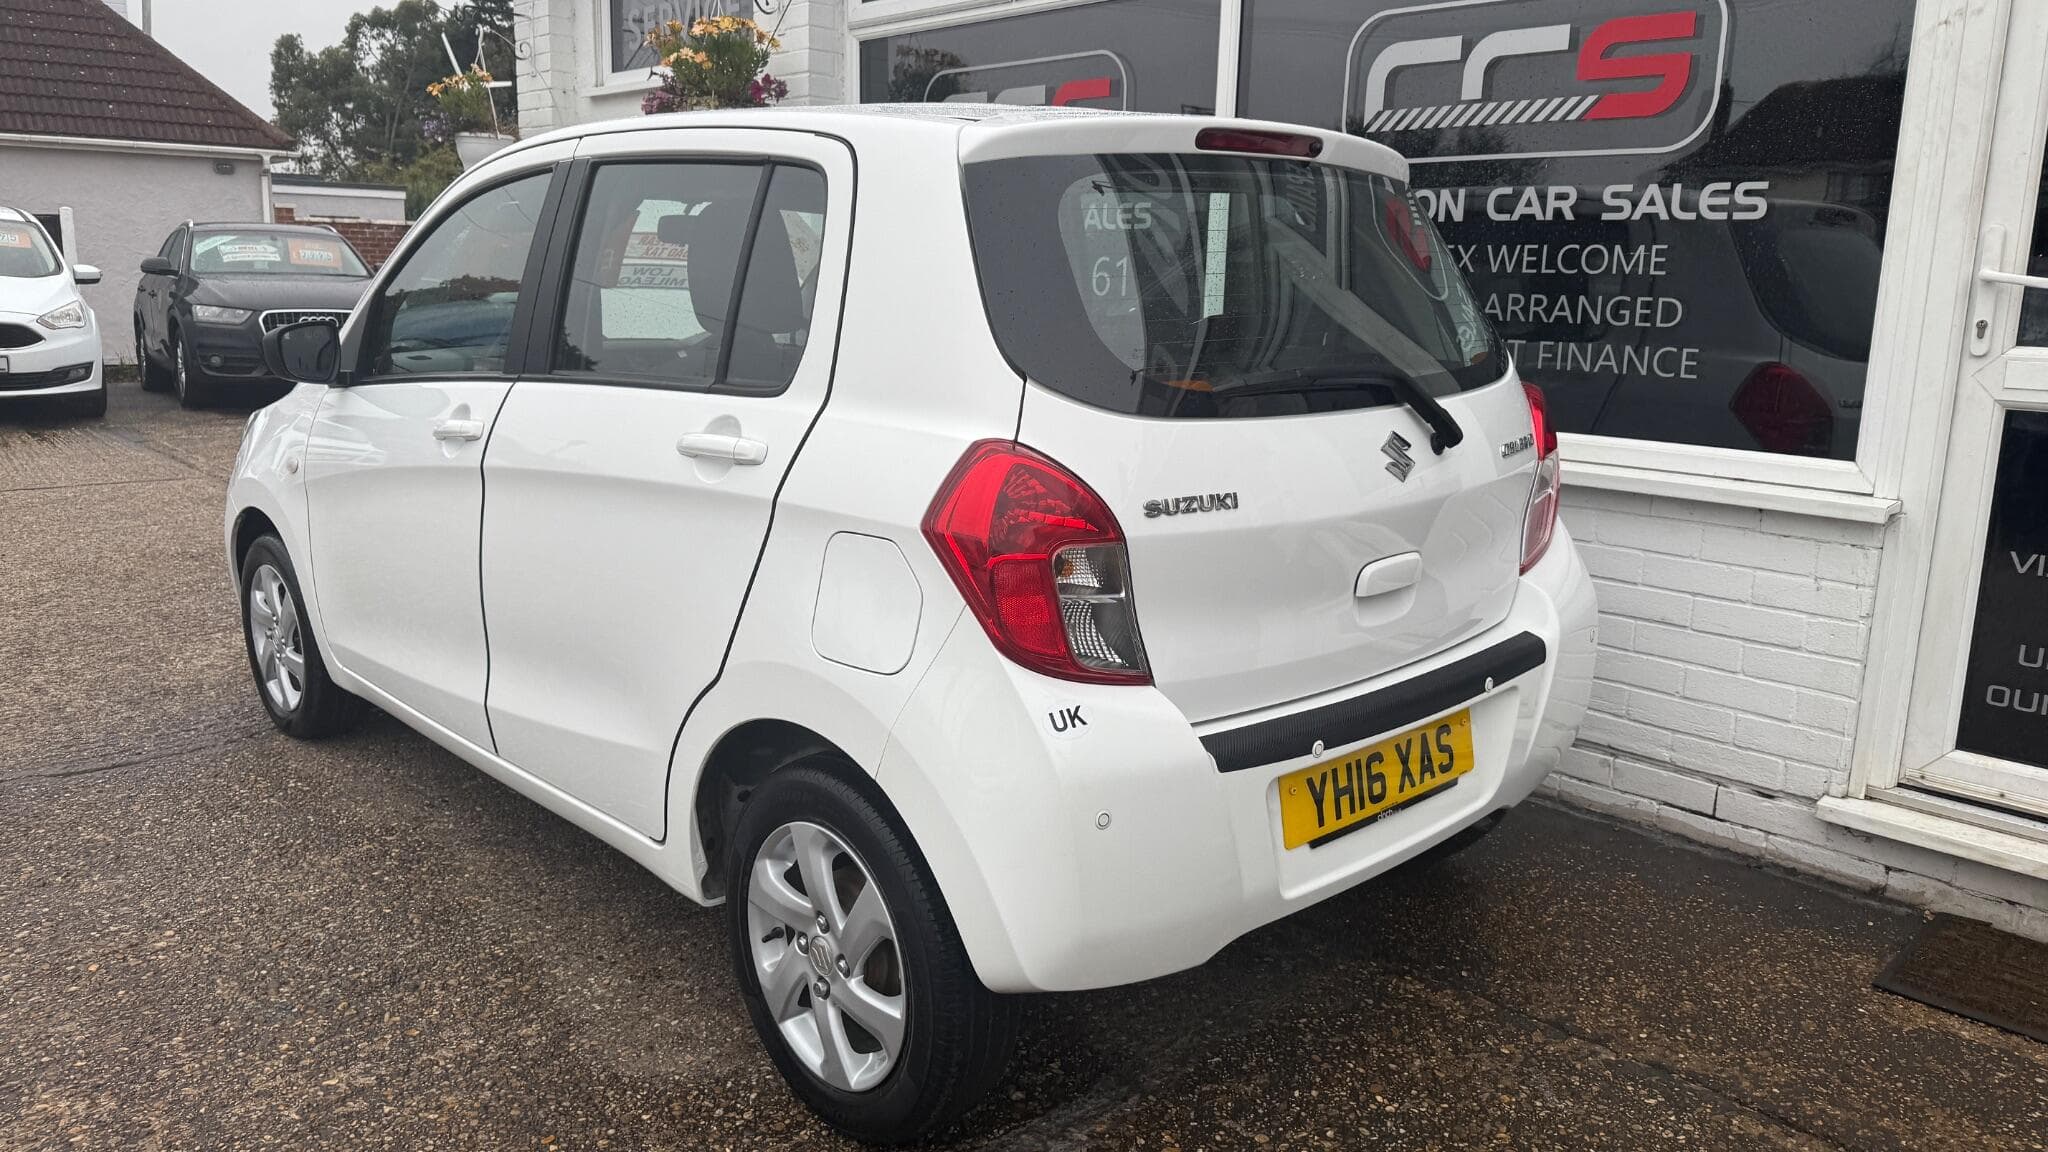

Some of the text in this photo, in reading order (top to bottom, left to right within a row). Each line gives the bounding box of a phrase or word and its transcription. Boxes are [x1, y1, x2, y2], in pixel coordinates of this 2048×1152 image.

[1084, 202, 1152, 230] ALES
[1414, 181, 1770, 222] ON CAR SALES
[1487, 244, 1669, 276] WELCOME
[1484, 292, 1683, 329] ARRANGED
[1537, 341, 1700, 379] FINANCE
[1143, 492, 1238, 519] SUZUKI
[2010, 551, 2048, 577] VI
[2018, 644, 2048, 670] U
[1048, 704, 1088, 732] UK
[1306, 723, 1455, 829] YH16 XAS
